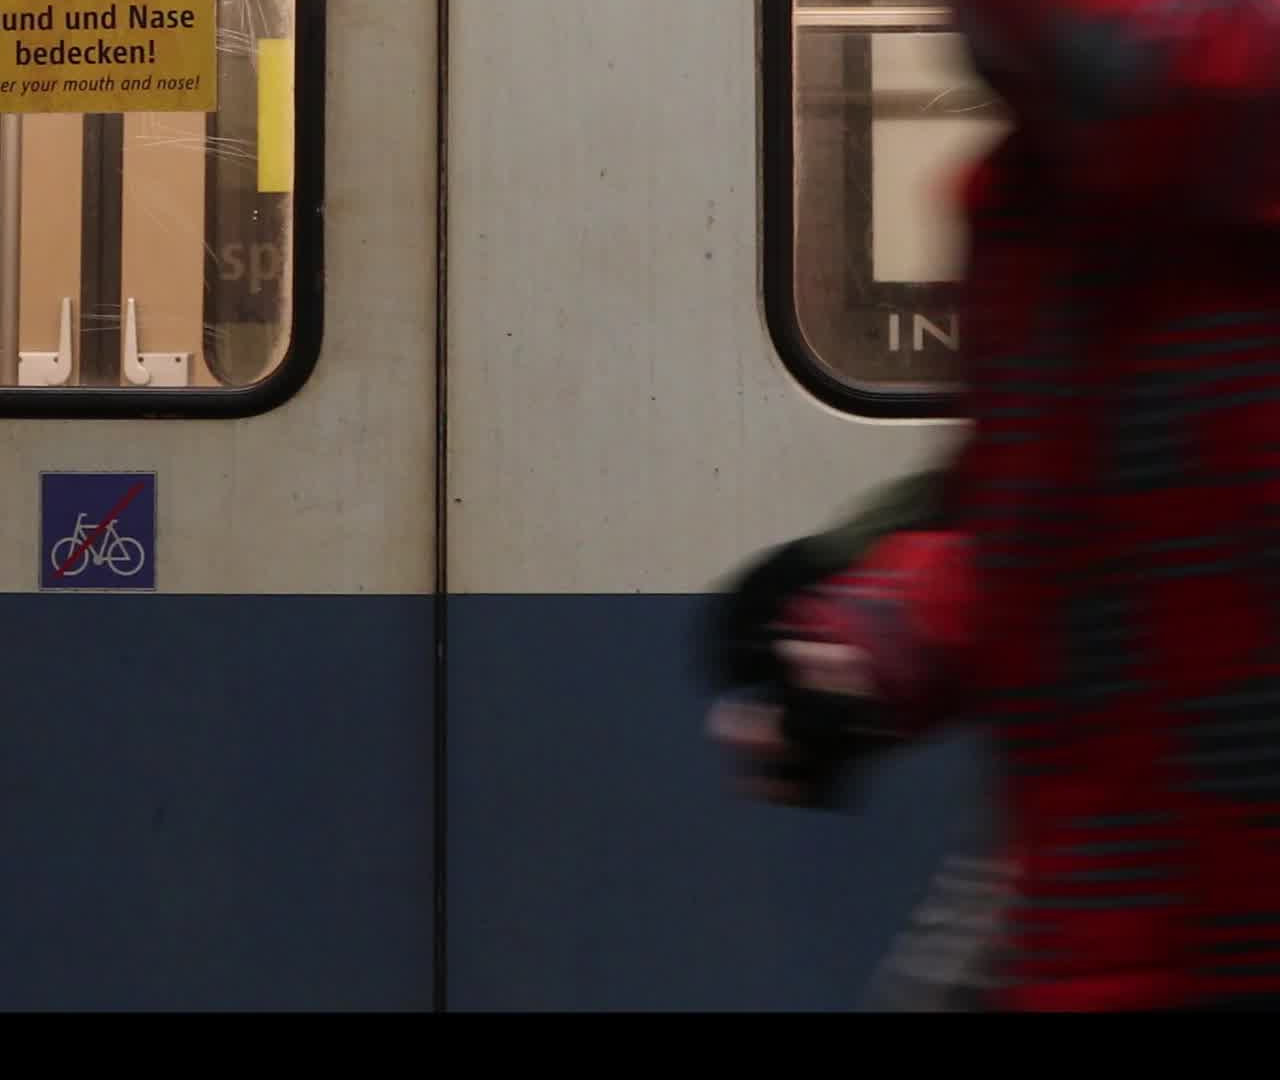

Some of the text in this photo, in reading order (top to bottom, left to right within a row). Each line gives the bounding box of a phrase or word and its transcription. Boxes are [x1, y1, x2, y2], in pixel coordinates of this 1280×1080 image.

[65, 3, 116, 30] und
[129, 4, 195, 29] Nase
[16, 39, 155, 66] bedecken!
[21, 78, 58, 96] your
[63, 76, 115, 92] mouth
[121, 75, 152, 91] and
[157, 75, 200, 91] nose!
